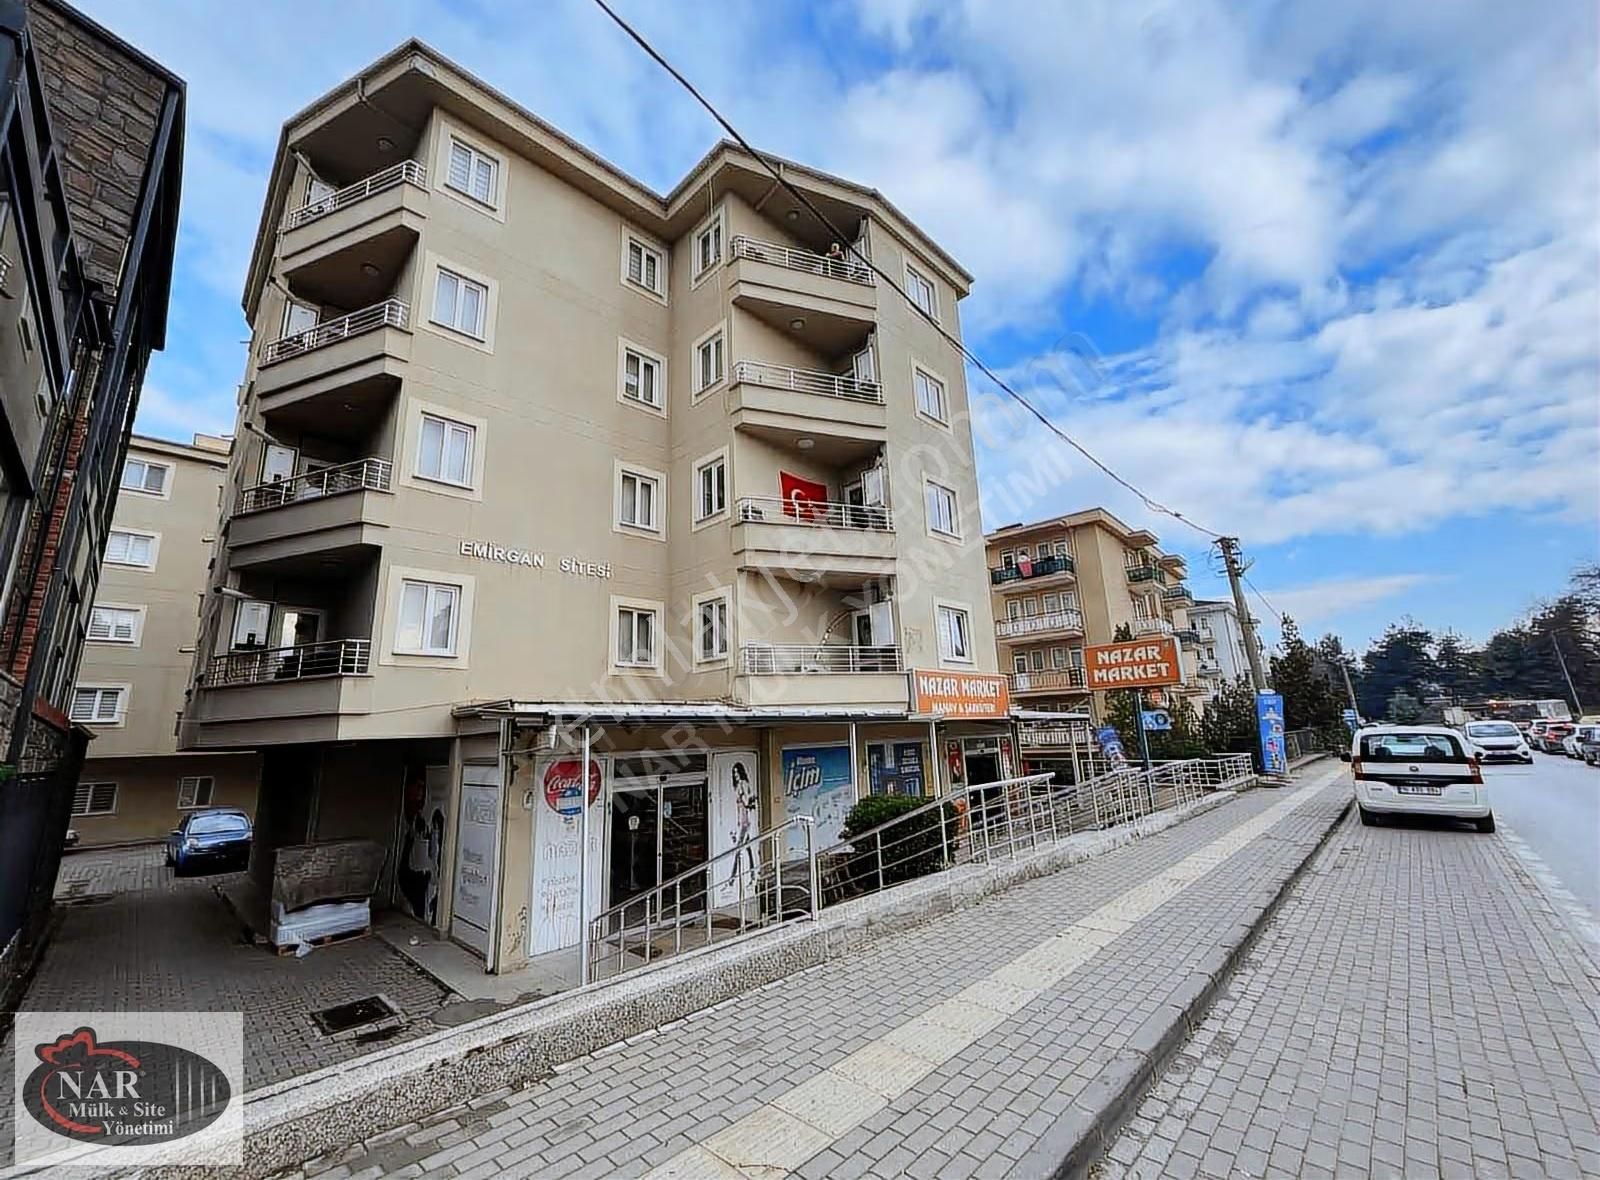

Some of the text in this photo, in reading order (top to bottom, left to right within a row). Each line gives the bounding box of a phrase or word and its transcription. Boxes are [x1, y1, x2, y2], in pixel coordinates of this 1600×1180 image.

[459, 541, 612, 578] EMİRGAN SİTESİ
[1097, 646, 1162, 665] NAZAR
[1094, 663, 1170, 682] MARKET
[920, 676, 1000, 699] NAZAR MARKET
